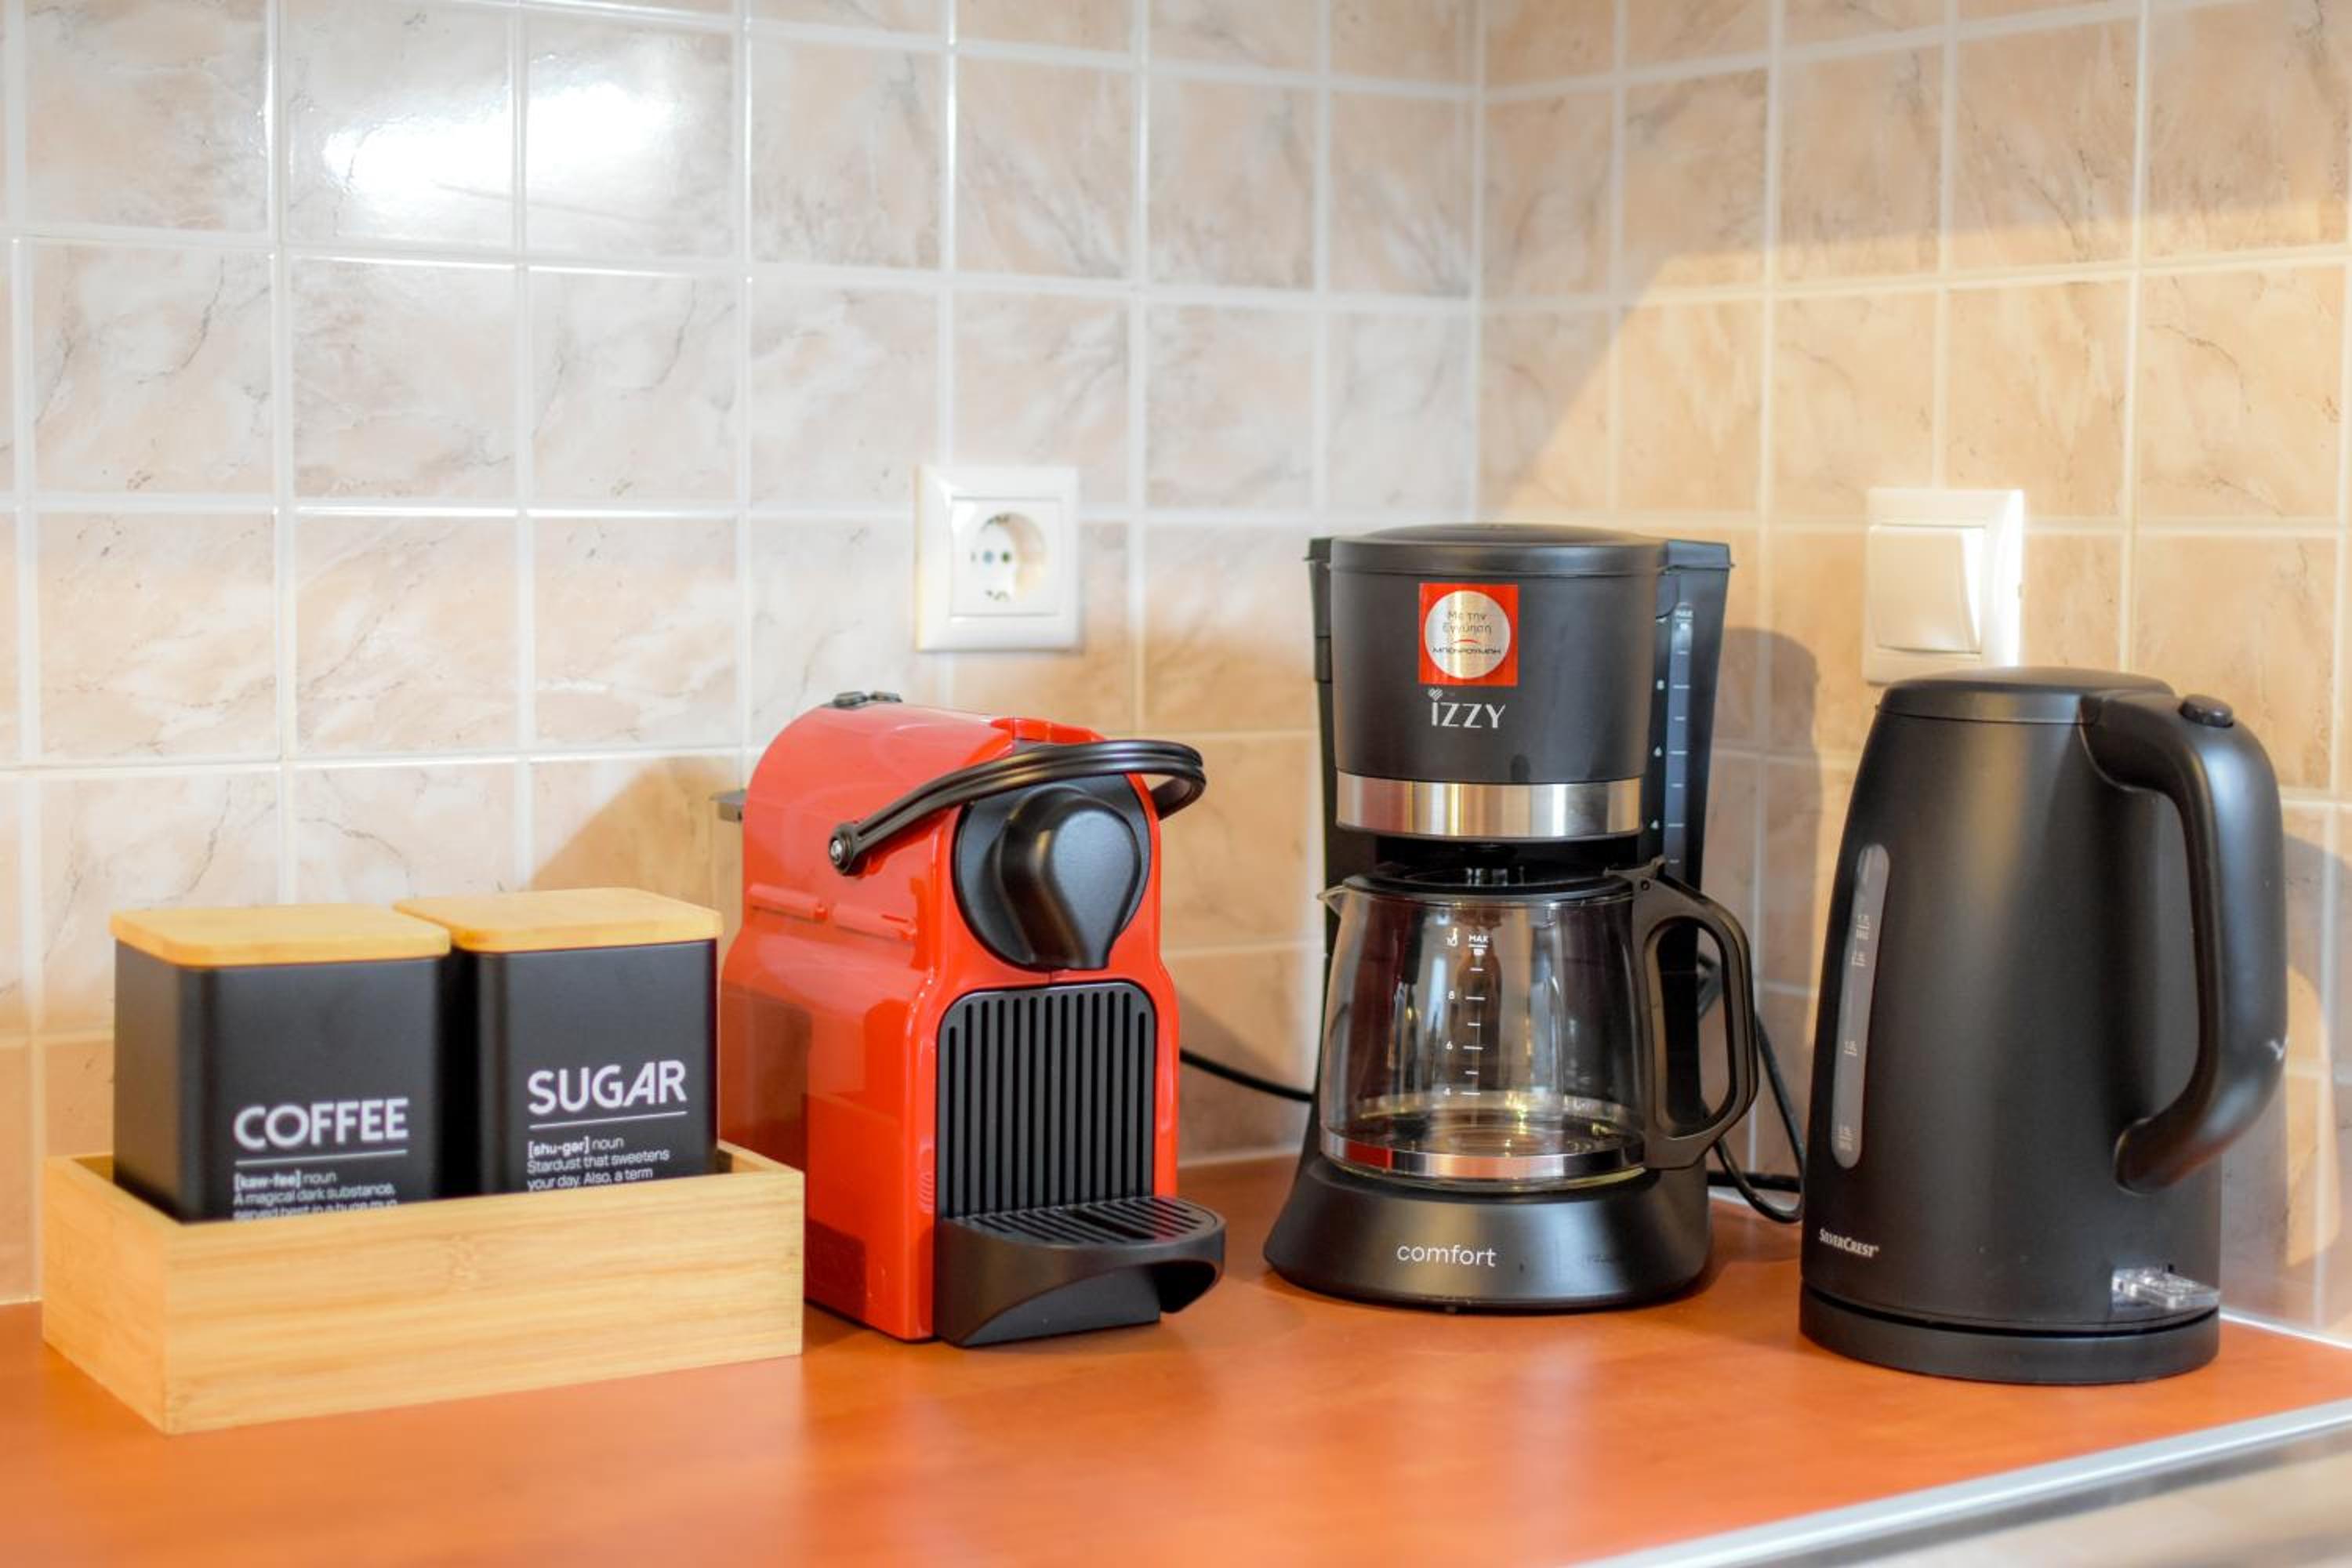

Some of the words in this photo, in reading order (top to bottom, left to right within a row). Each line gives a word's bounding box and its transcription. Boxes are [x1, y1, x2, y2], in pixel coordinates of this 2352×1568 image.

[528, 1060, 688, 1115] SUGAR
[234, 1098, 408, 1150] COFFEE
[592, 1138, 625, 1150] noun
[527, 1159, 582, 1175] Stardust
[583, 1155, 609, 1169] that
[611, 1149, 670, 1166] sweetens
[303, 1171, 336, 1185] noun
[527, 1178, 555, 1192] your
[614, 1172, 622, 1181] a
[625, 1168, 654, 1180] term
[234, 1191, 244, 1207] A
[245, 1189, 296, 1207] magical
[297, 1187, 325, 1202] dark
[1396, 1244, 1497, 1267] comfort
